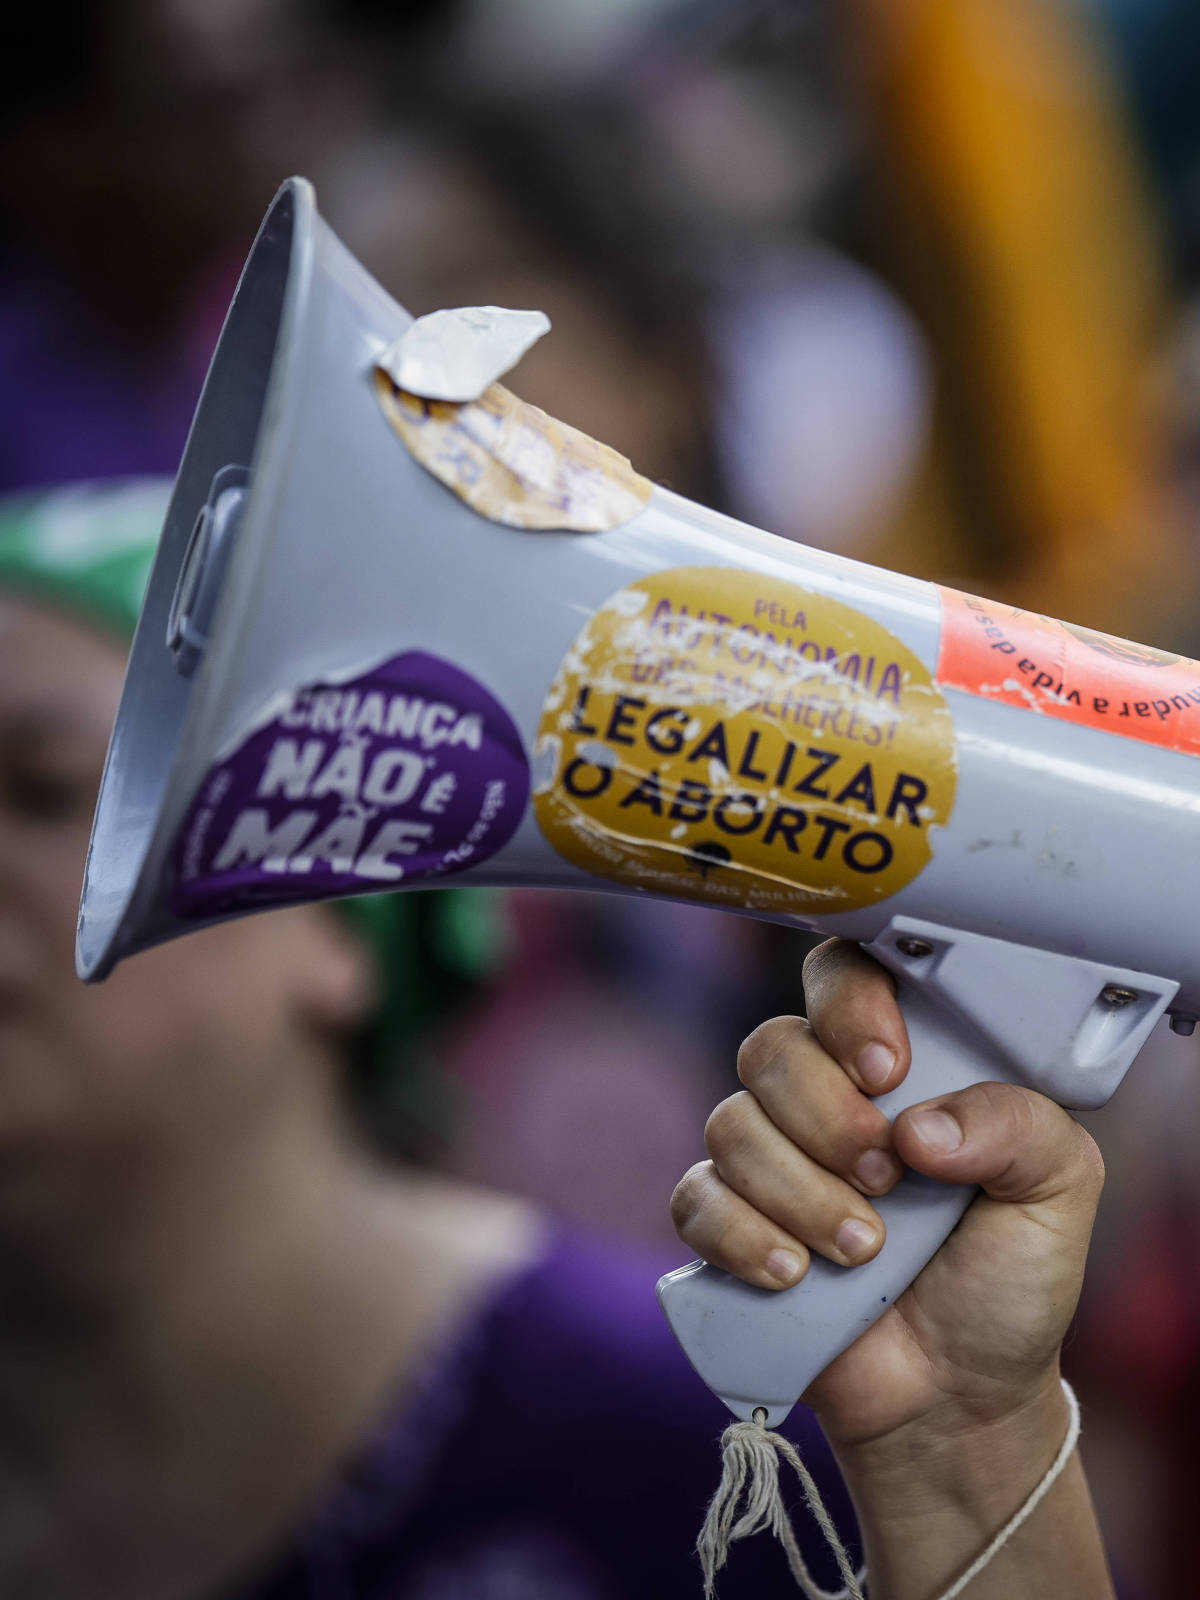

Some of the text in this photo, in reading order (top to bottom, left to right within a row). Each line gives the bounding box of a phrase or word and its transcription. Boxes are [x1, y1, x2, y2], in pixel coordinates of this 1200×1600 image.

[649, 598, 902, 704] AUTONOMIA
[753, 598, 808, 632] PELA
[975, 615, 1017, 655] das
[1016, 657, 1082, 707] vida
[1092, 697, 1110, 714] a
[257, 730, 427, 806] NÃO
[570, 685, 930, 829] LEGALIZAR
[212, 802, 435, 881] MÃE
[562, 755, 612, 799] O
[618, 770, 894, 875] ABORTO
